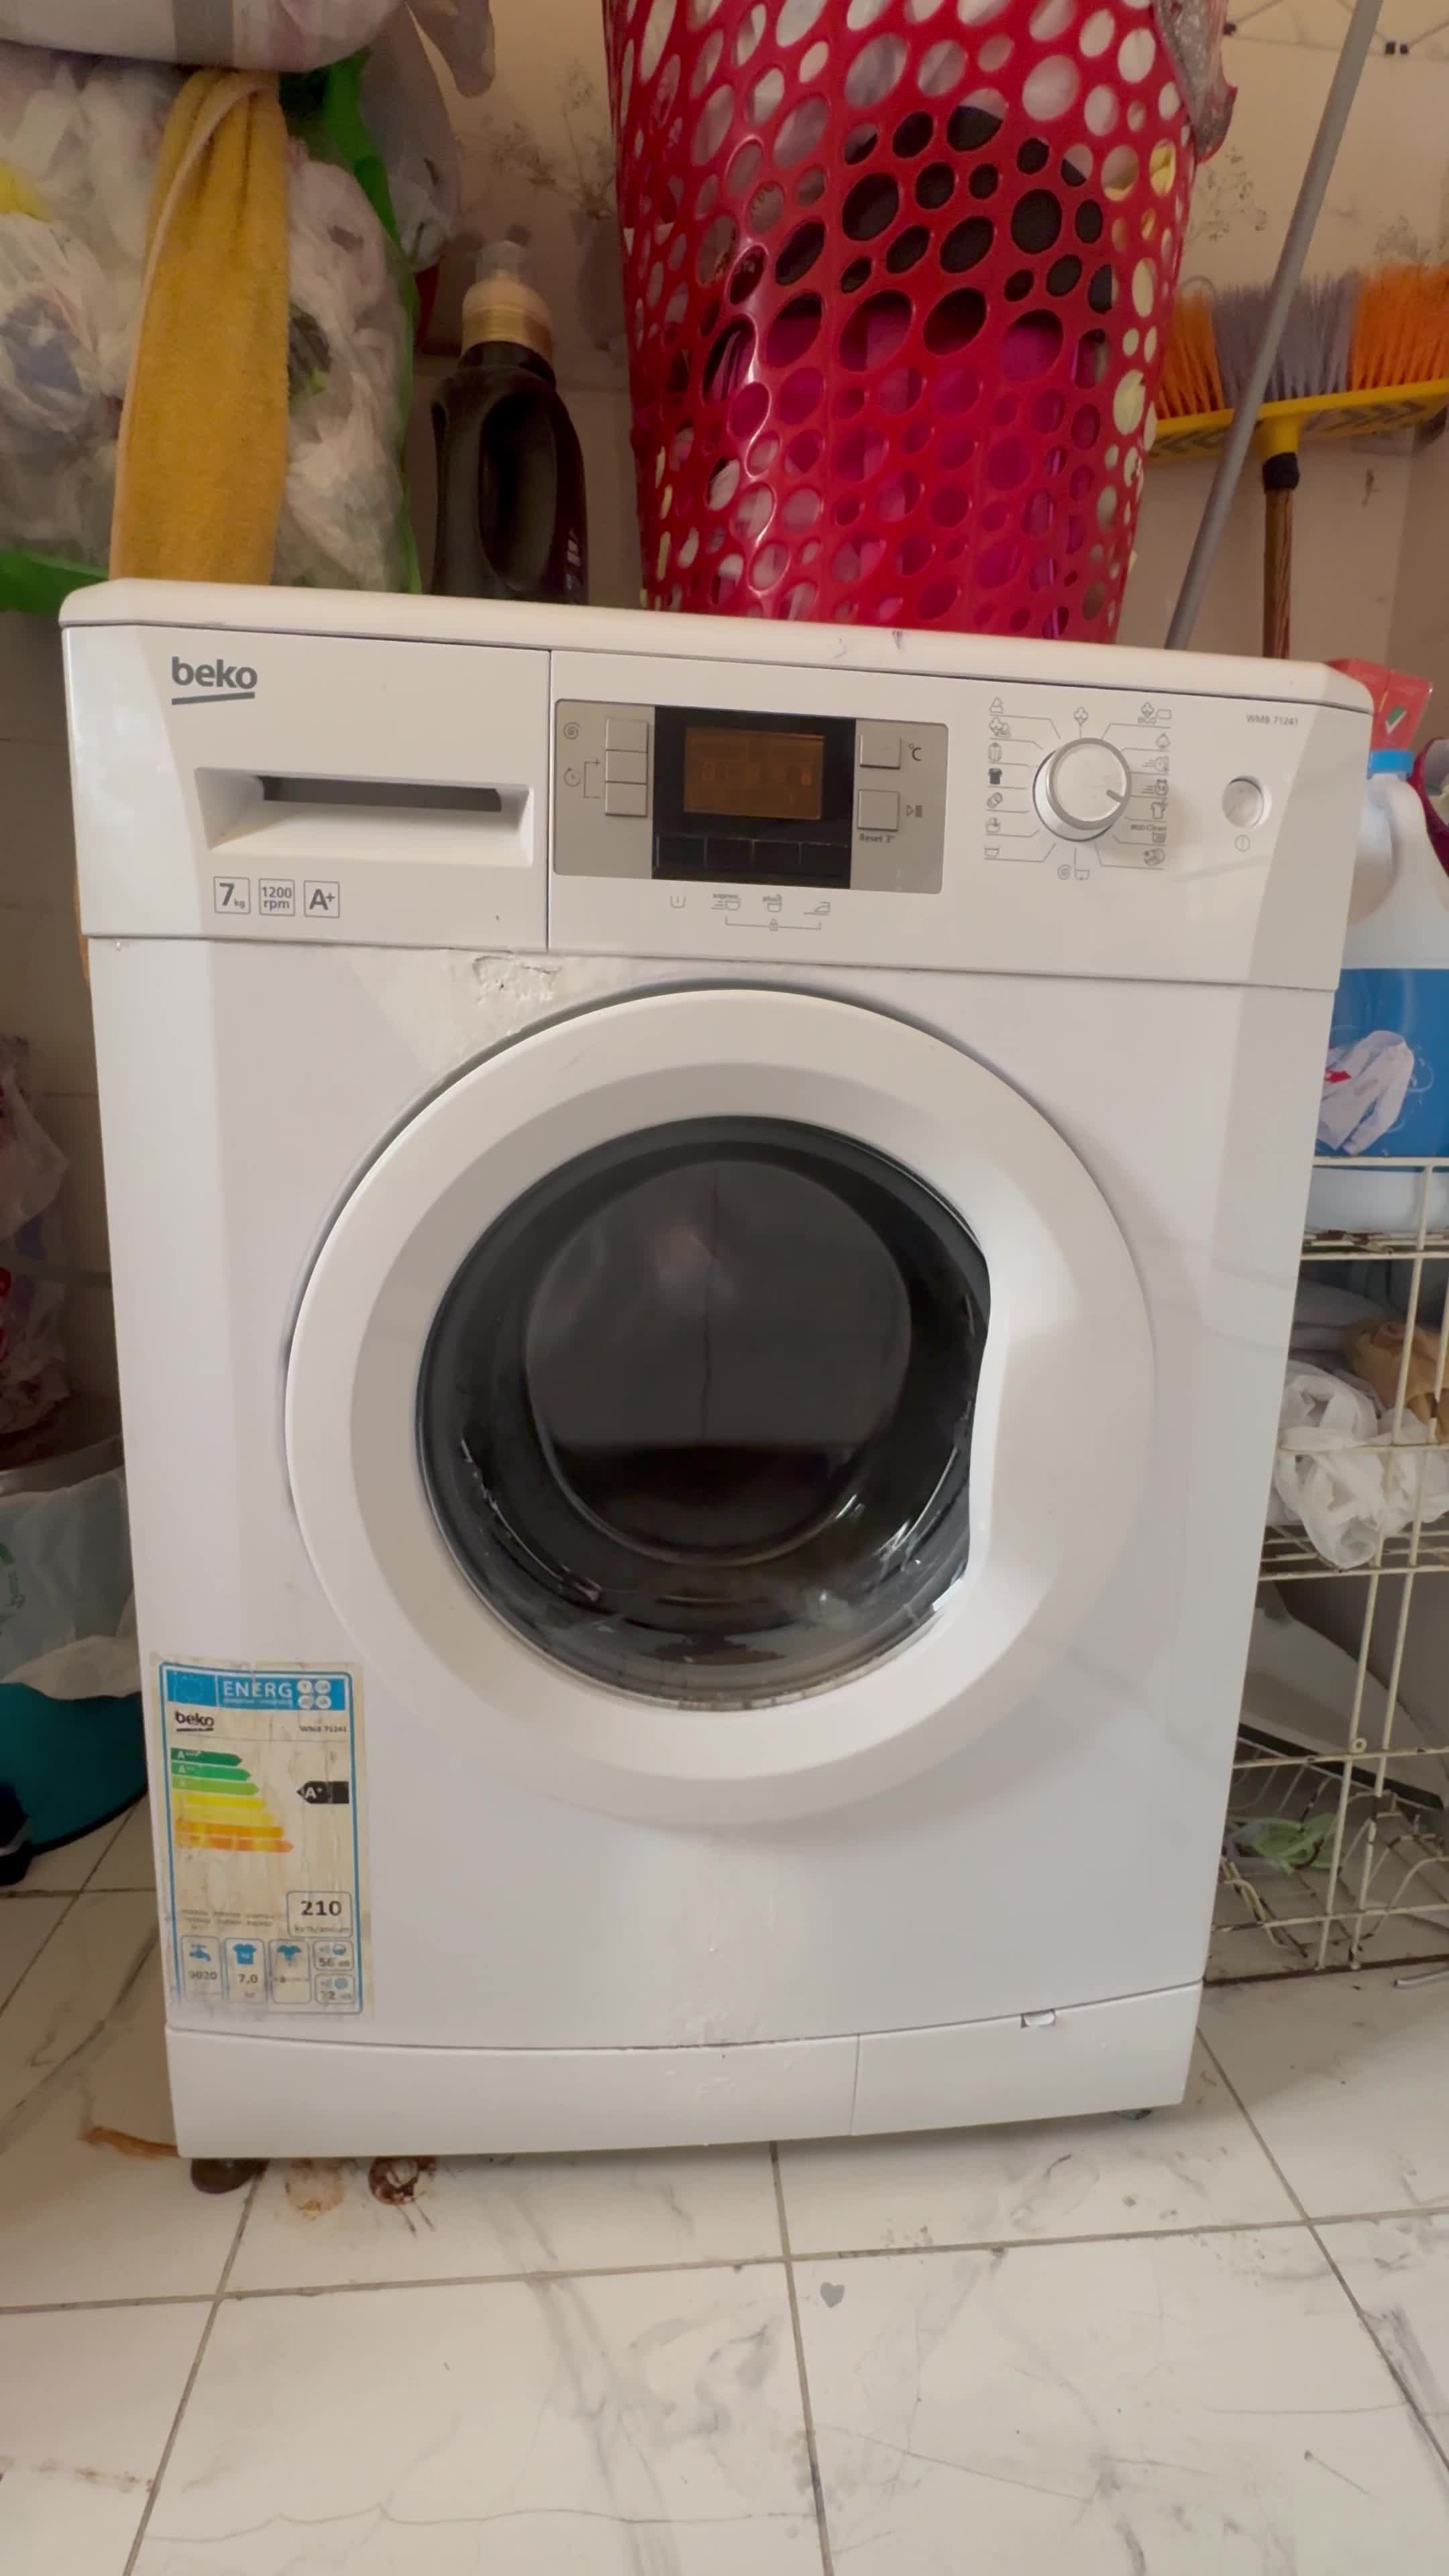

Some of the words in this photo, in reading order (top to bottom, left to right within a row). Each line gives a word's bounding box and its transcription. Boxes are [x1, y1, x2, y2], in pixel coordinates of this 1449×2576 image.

[172, 656, 258, 689] beko
[1273, 715, 1299, 725] 71241
[859, 833, 883, 842] Reset
[262, 885, 292, 898] 1200
[263, 899, 290, 912] rpm
[309, 888, 335, 910] A+
[223, 1681, 292, 1698] ENERG
[175, 1711, 215, 1726] beko
[301, 1900, 342, 1917] 210
[238, 1974, 258, 1984] 7,0
